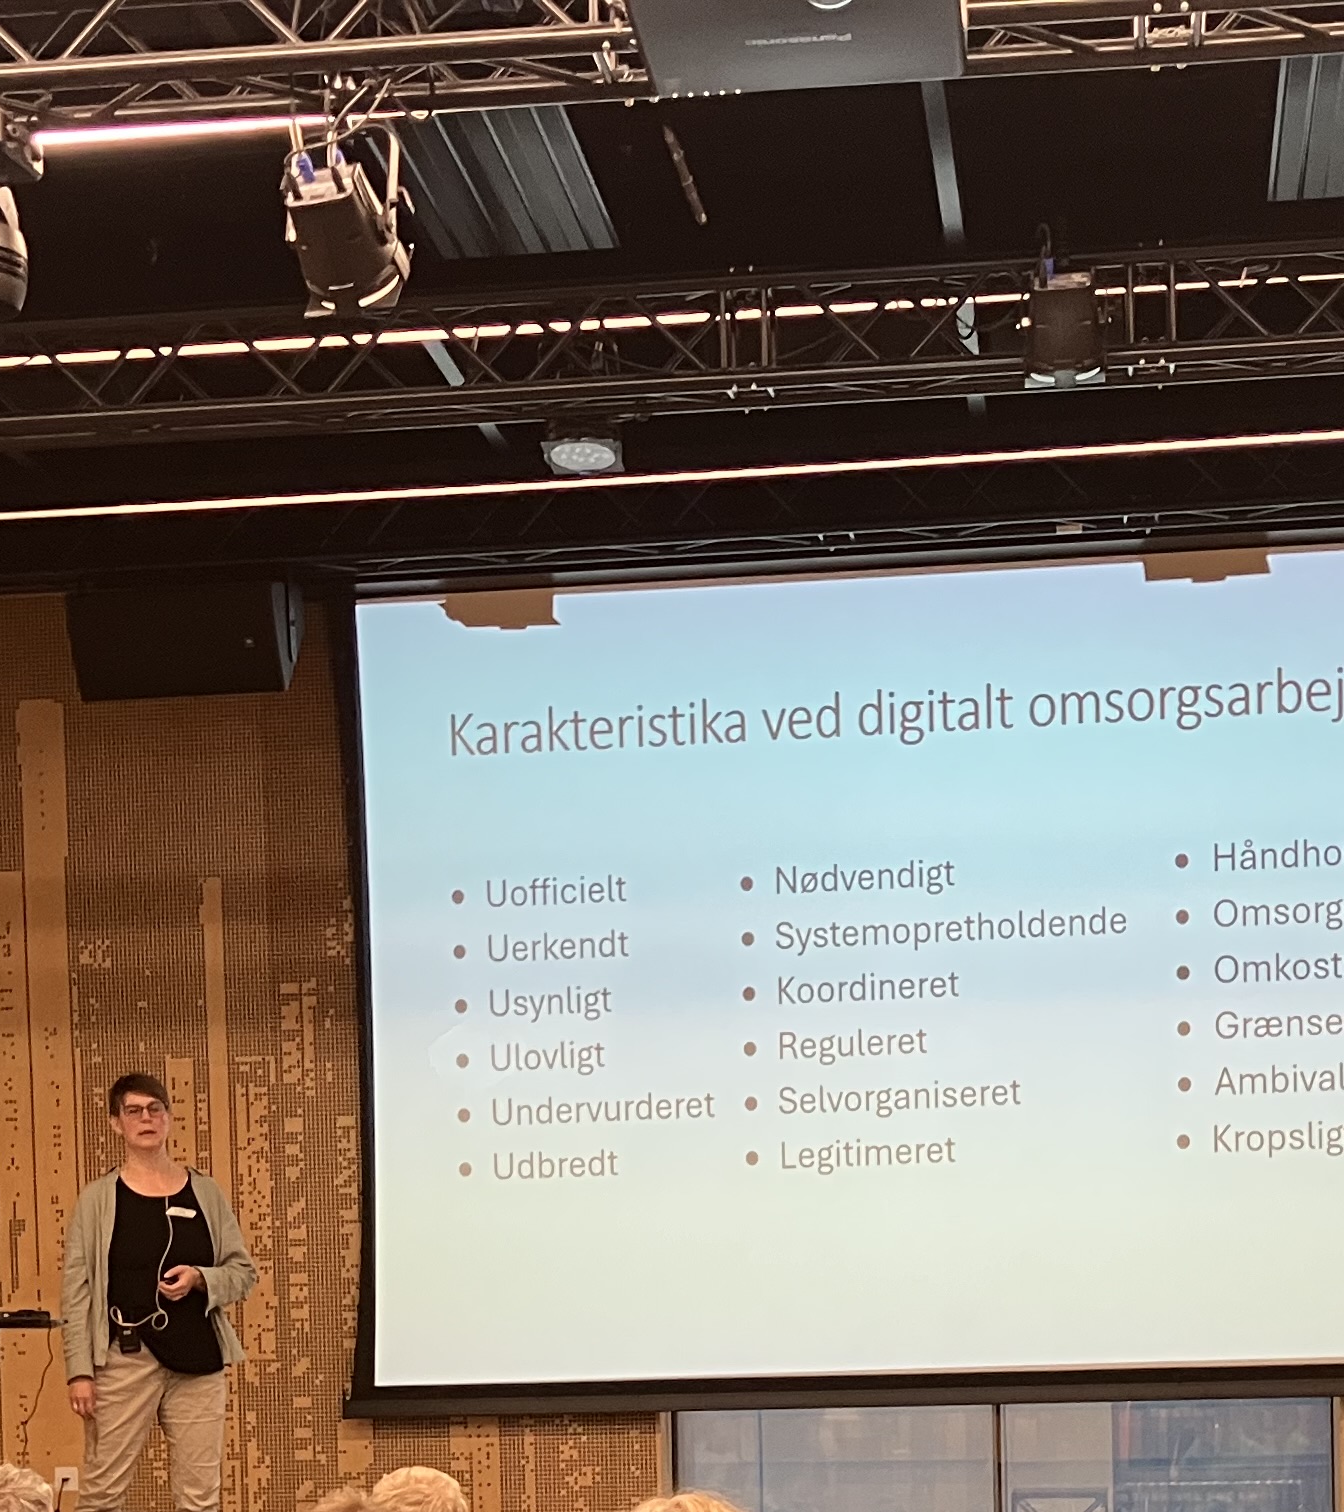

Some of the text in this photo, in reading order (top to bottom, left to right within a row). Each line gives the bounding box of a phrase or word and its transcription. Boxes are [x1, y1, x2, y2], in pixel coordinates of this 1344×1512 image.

[450, 700, 747, 757] Karakteristika
[760, 690, 841, 742] ved
[857, 682, 1016, 746] digitalt
[486, 872, 628, 908] Uofficielt
[775, 859, 956, 896] Nødvendigt
[487, 929, 630, 964] Uerkendt
[775, 908, 1127, 956] Systemopretholdende
[488, 984, 613, 1024] Usynligt
[777, 970, 960, 1006] Koordineret
[490, 1039, 606, 1077] Ulovligt
[778, 1027, 928, 1067] Reguleret
[491, 1091, 716, 1127] Undervurderet
[778, 1079, 1022, 1121] Selvorganiseret
[493, 1147, 619, 1181] Udbredt
[780, 1136, 957, 1177] Legitimeret
